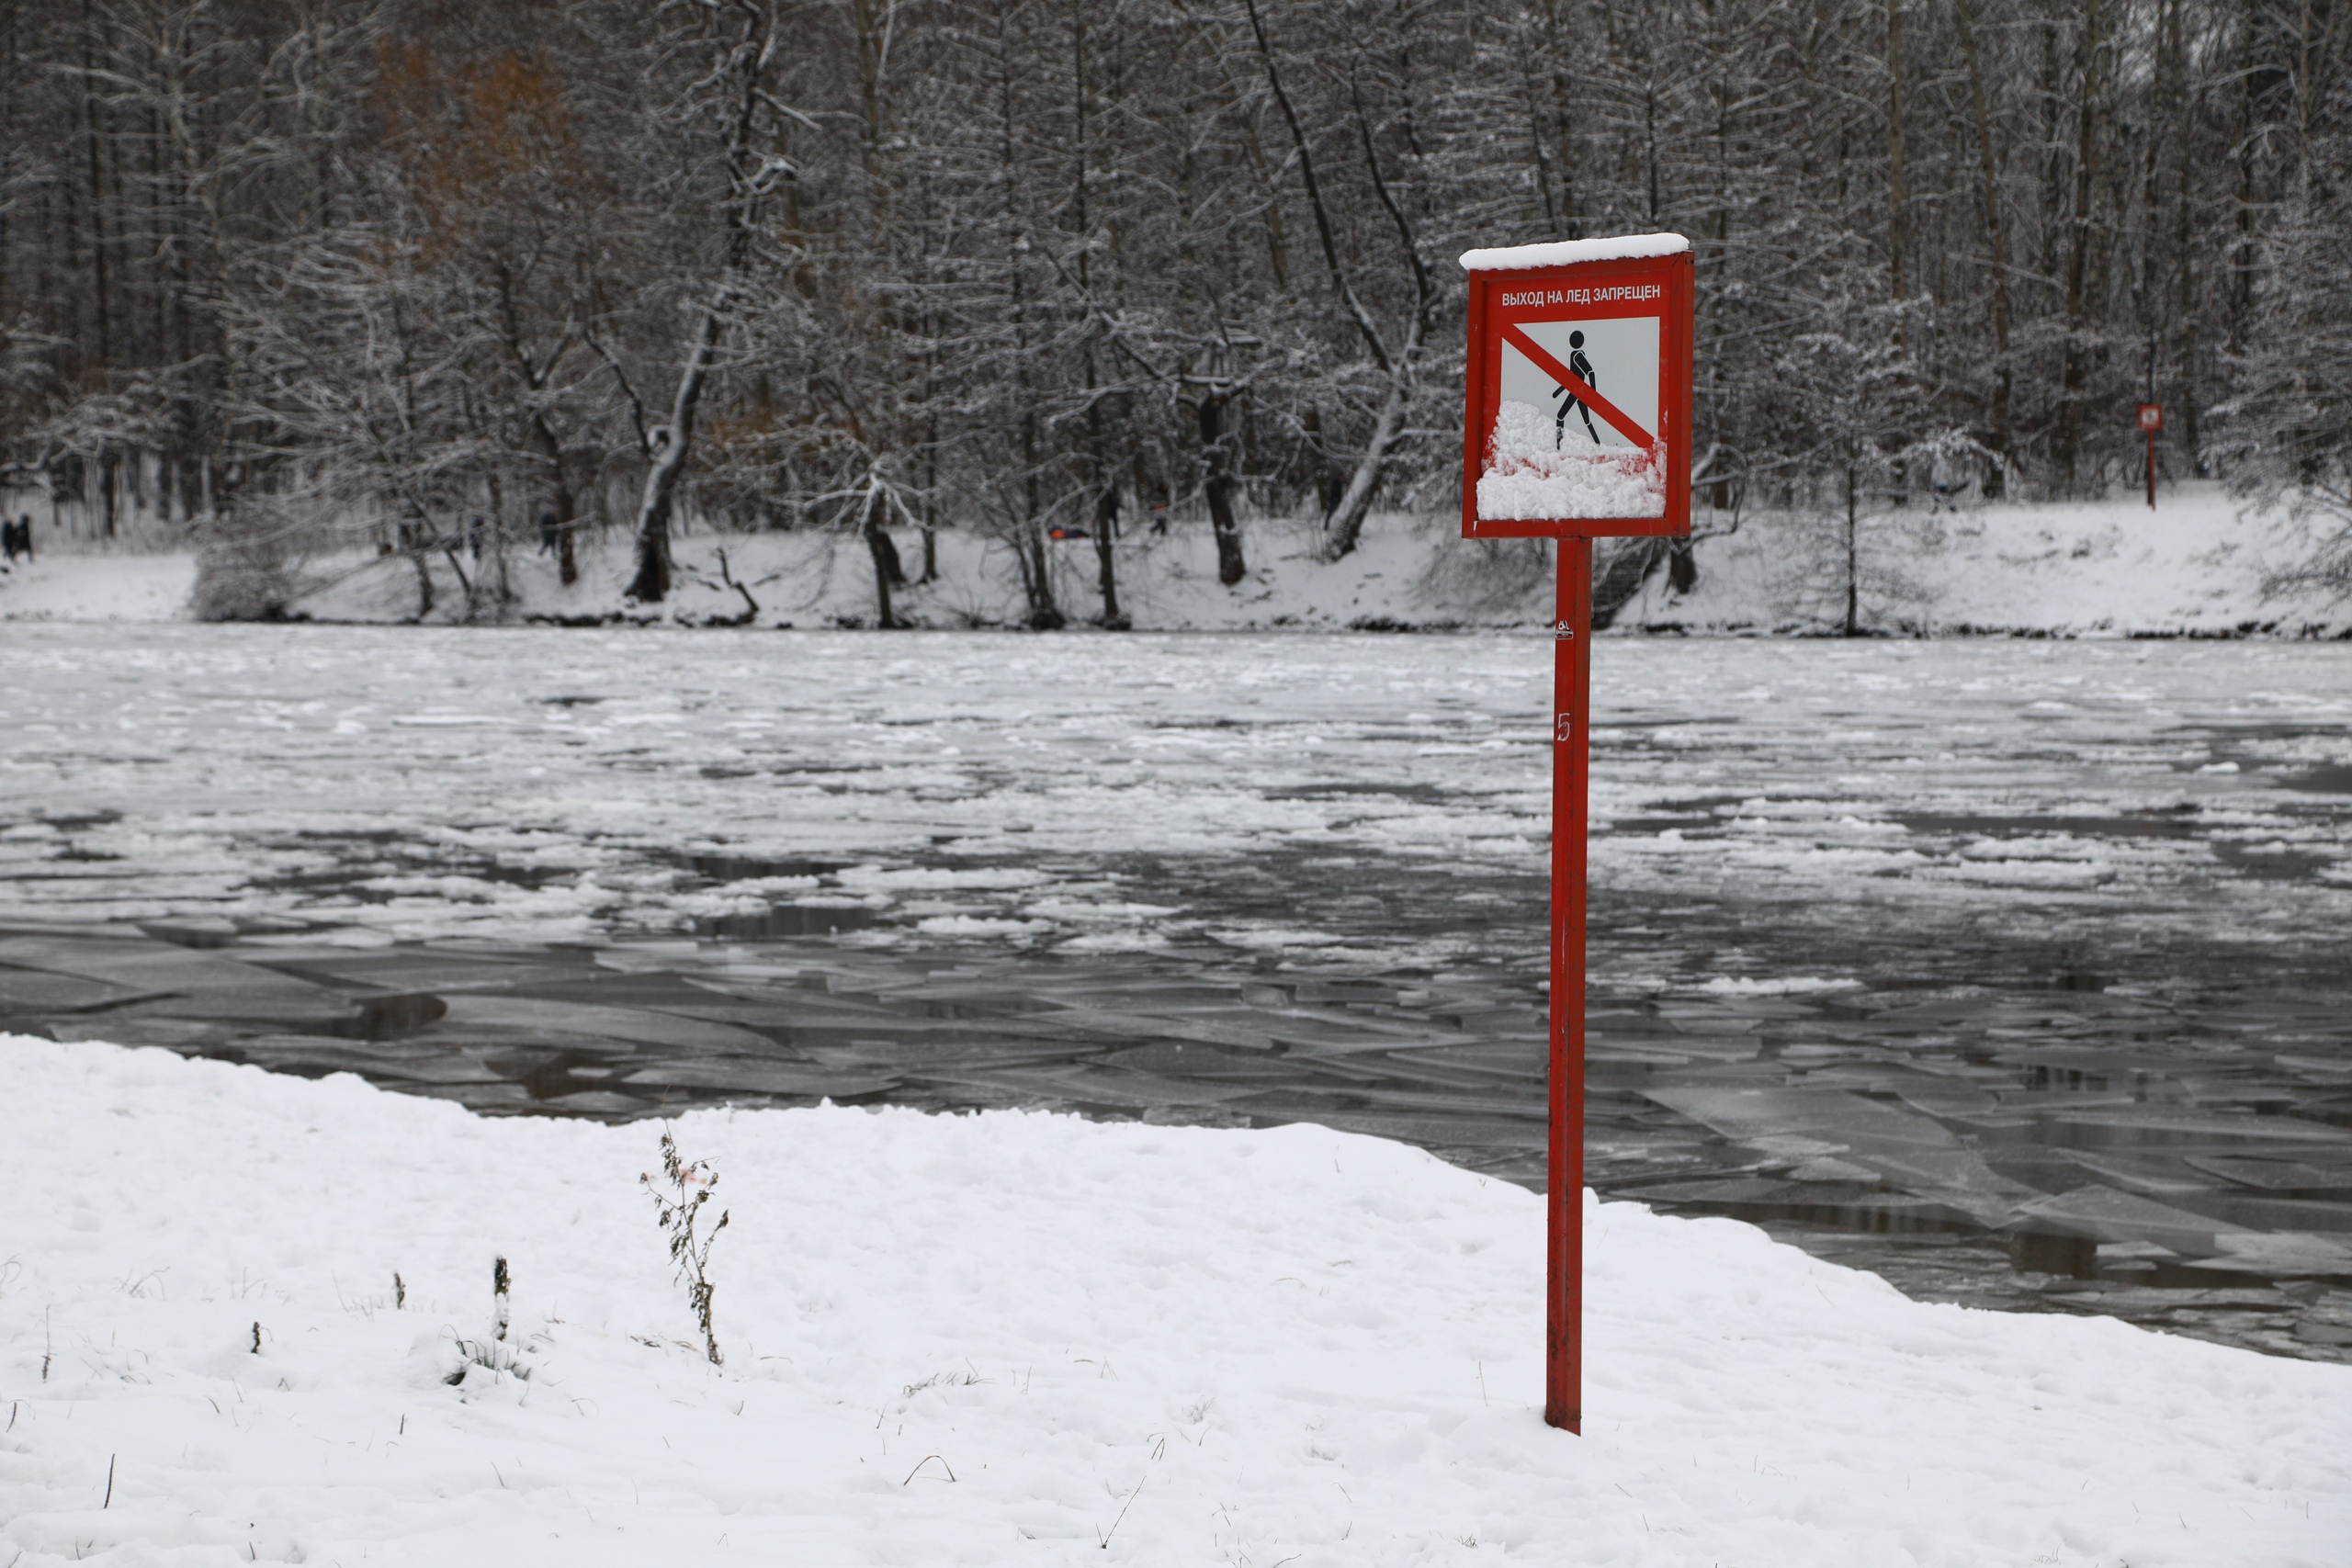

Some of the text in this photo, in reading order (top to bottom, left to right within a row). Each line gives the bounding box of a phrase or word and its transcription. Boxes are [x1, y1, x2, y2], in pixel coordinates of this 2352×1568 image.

[1502, 285, 1660, 307] ВЫХОД НА ЛЕД ЗАПРЕЩЕН
[1557, 713, 1570, 741] 5
